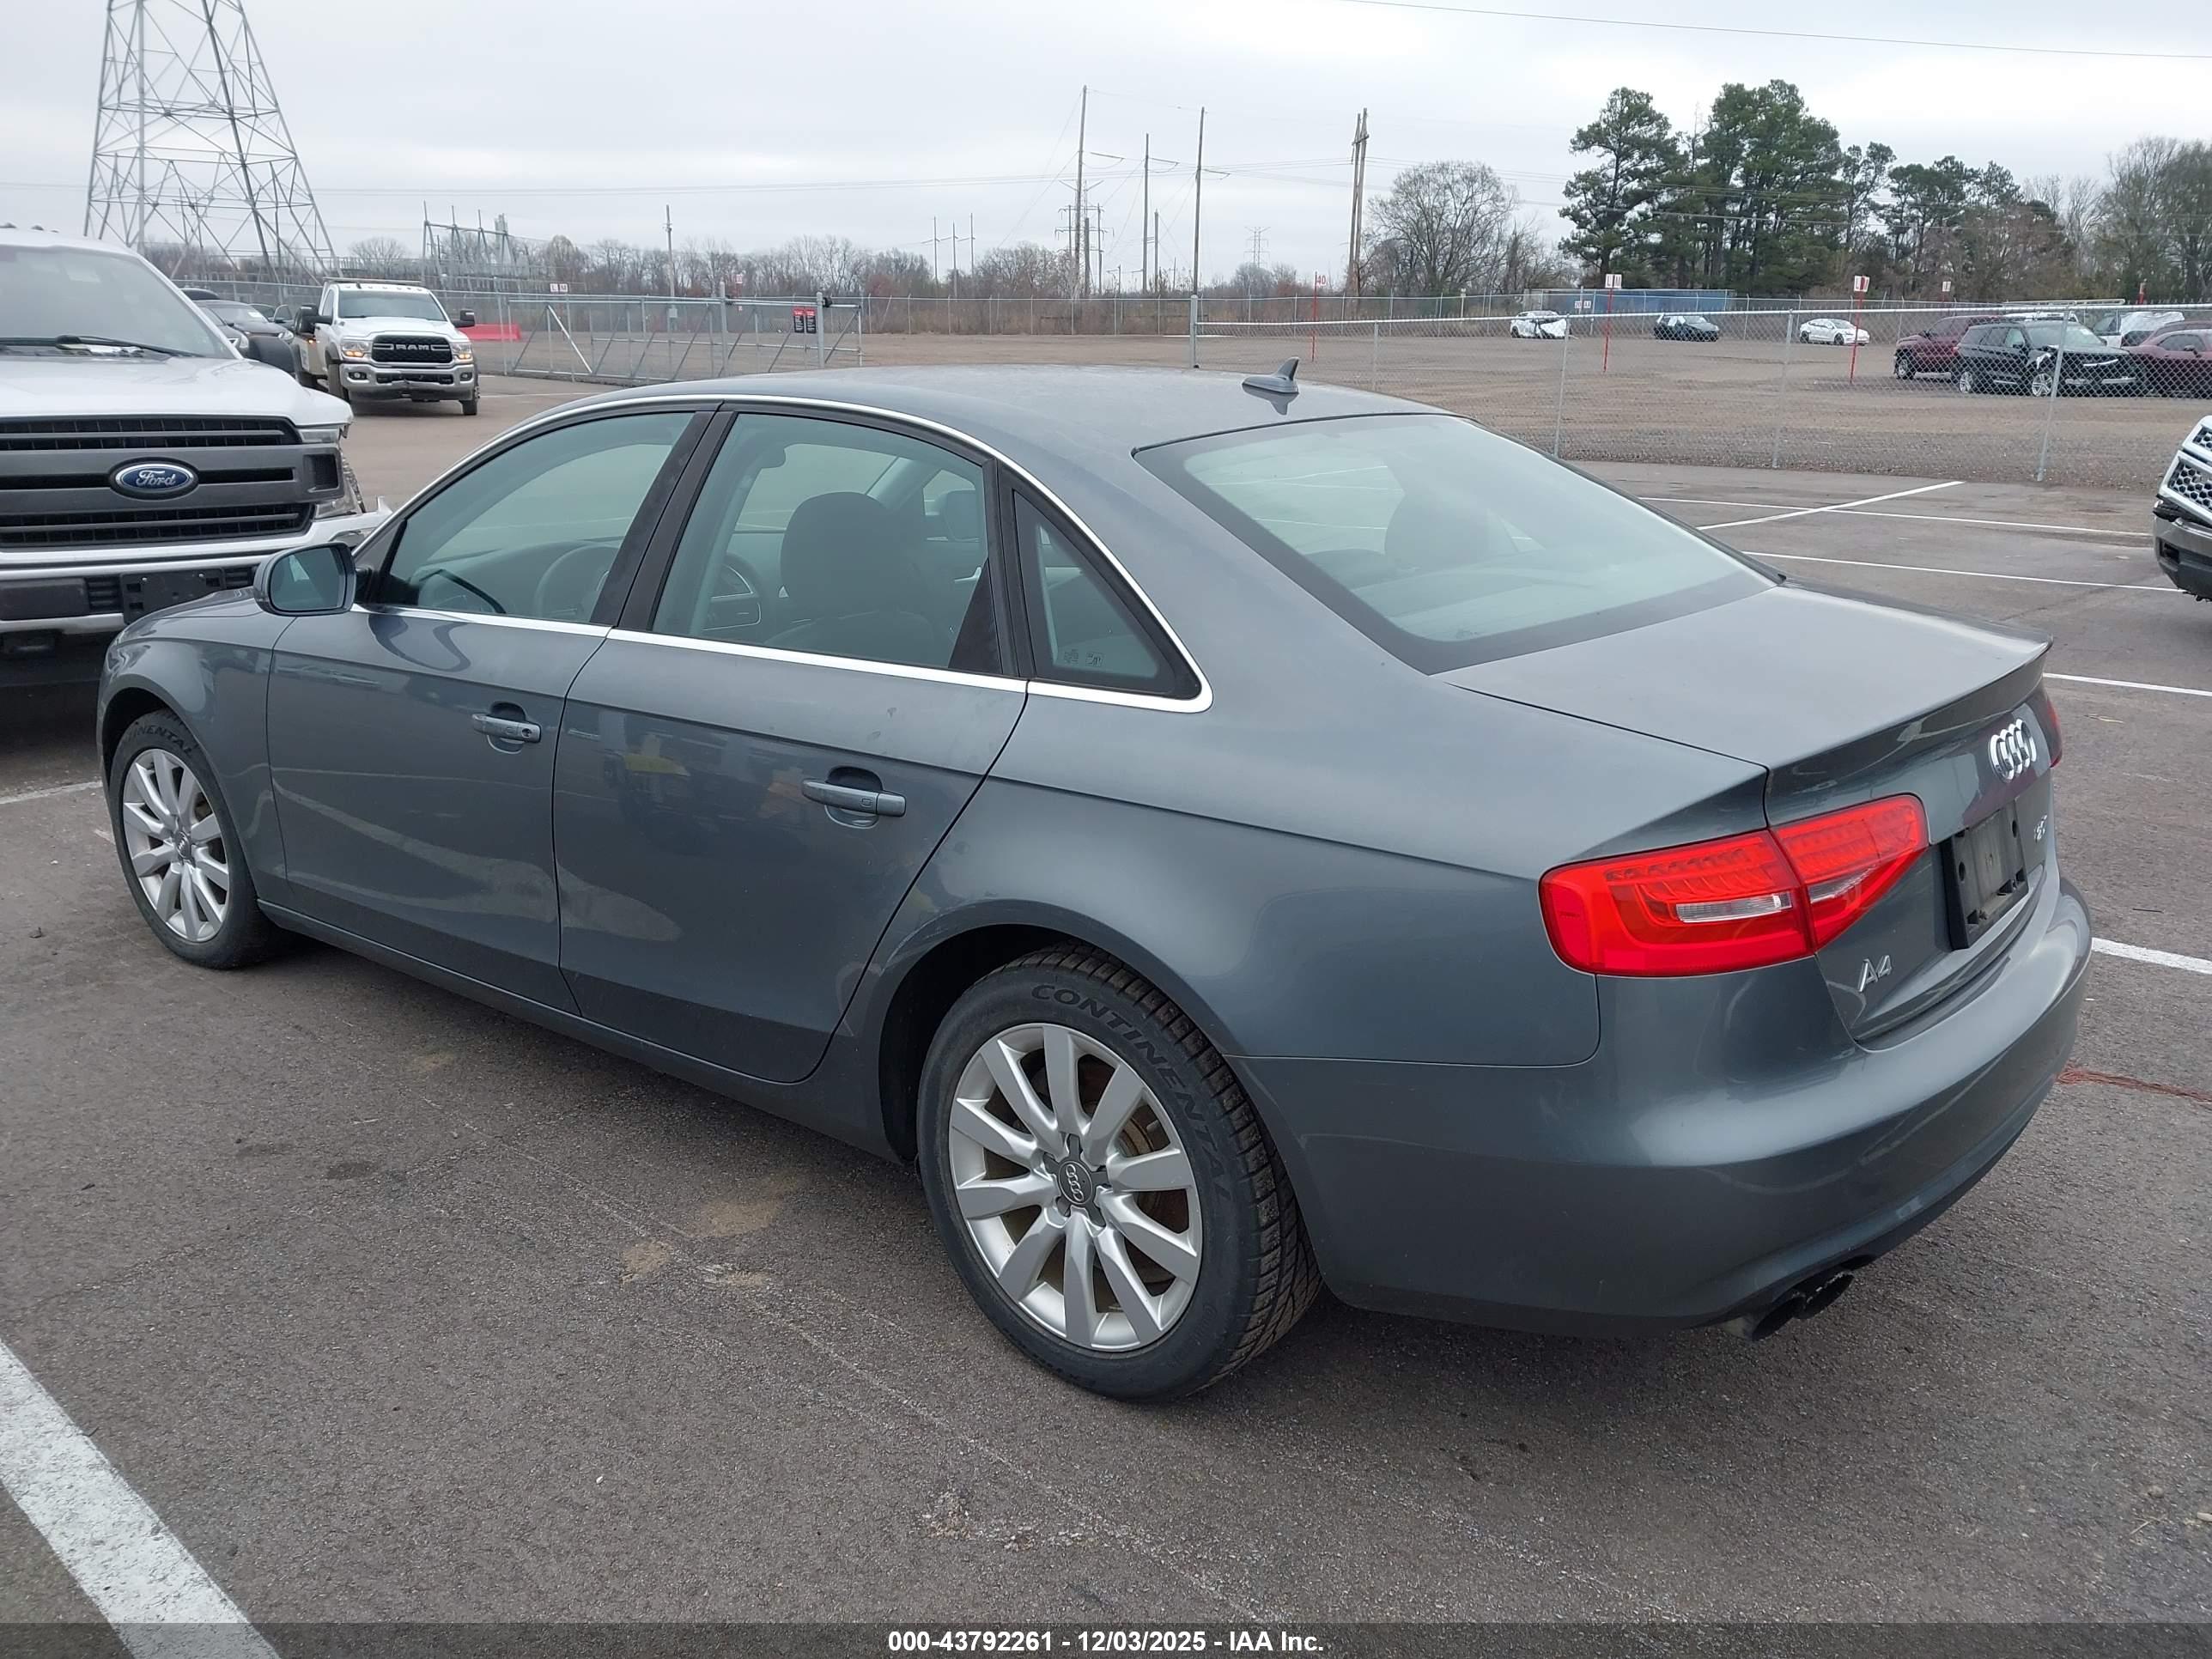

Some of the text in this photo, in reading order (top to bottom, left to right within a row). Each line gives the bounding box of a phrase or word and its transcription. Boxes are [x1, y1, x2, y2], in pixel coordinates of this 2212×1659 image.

[136, 470, 176, 487] Ford
[1857, 955, 1892, 992] A4
[1030, 985, 1232, 1200] CONTINENTAL
